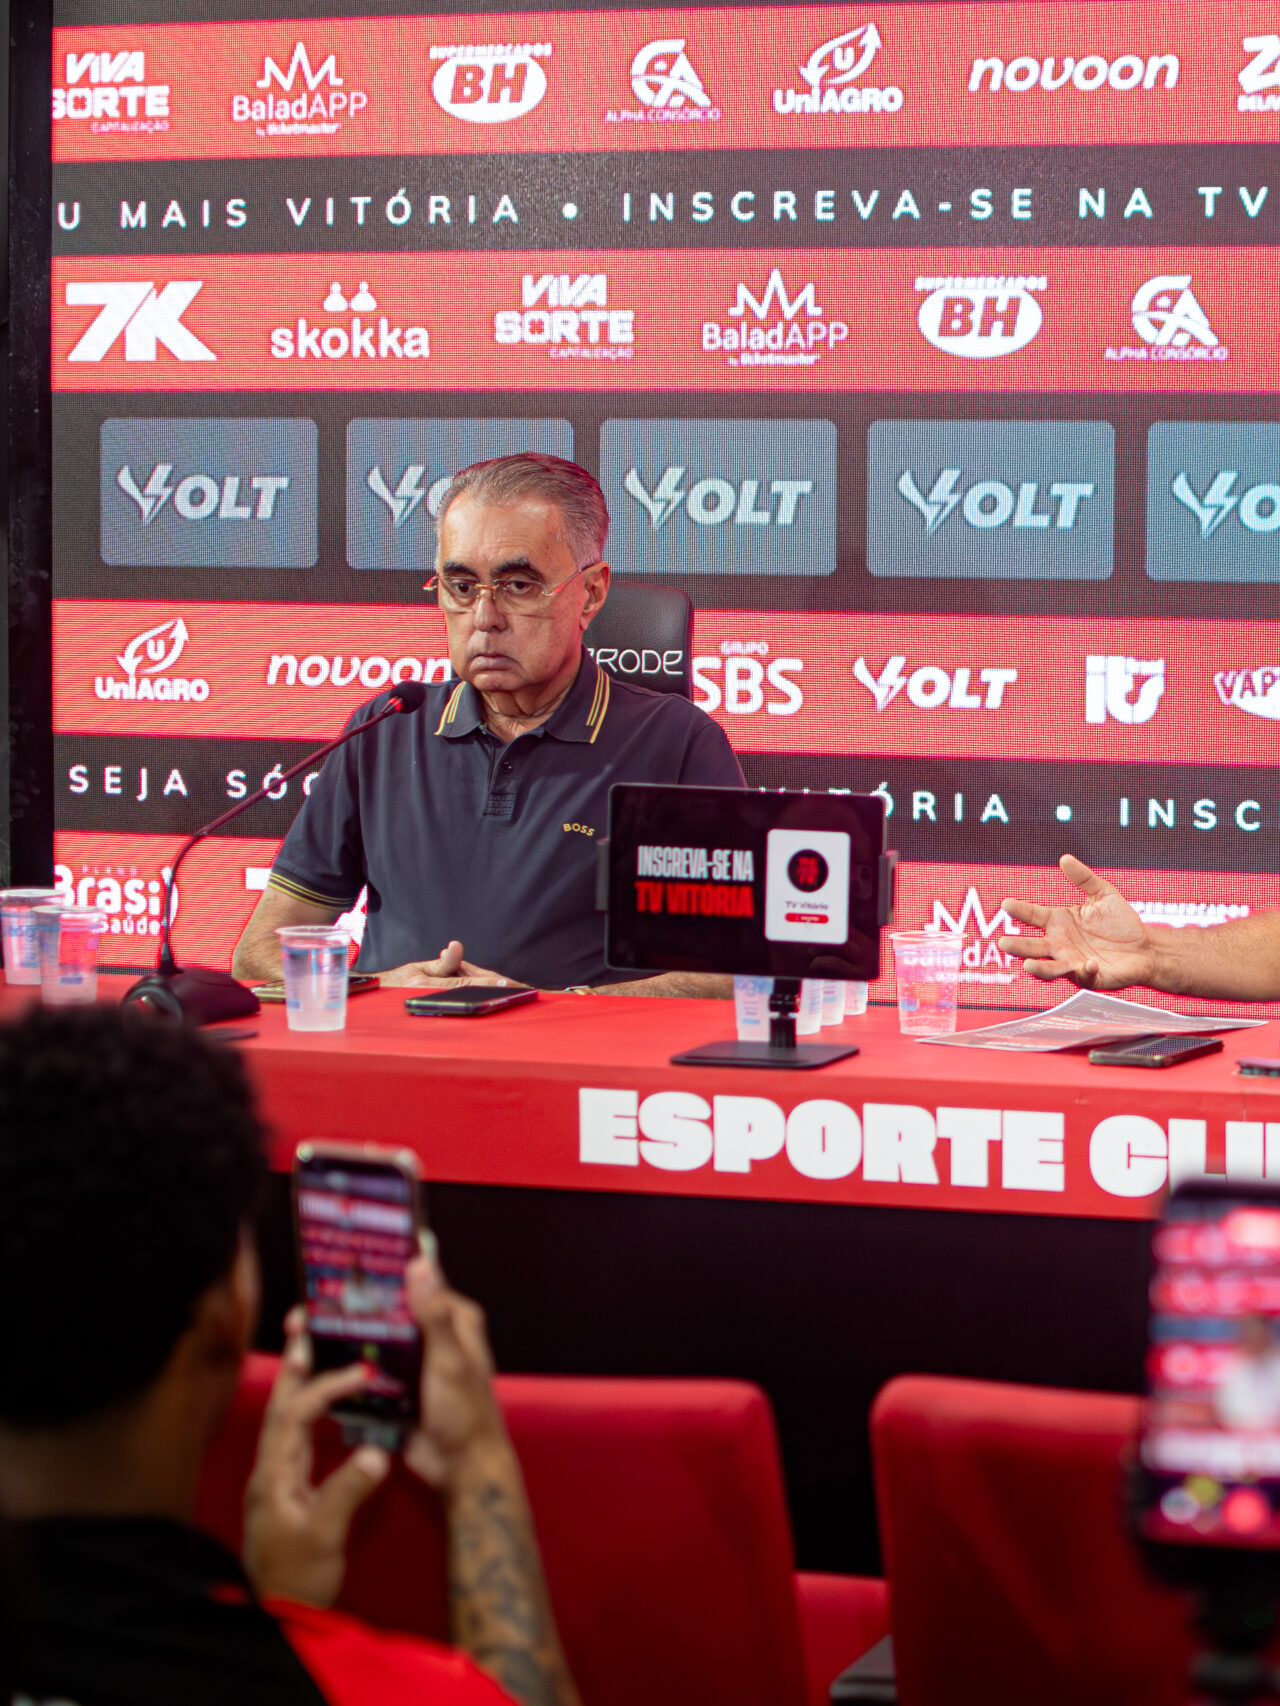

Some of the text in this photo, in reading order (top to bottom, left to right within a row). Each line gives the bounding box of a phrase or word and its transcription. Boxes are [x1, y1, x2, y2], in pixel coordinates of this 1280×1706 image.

[67, 51, 144, 83] VIVA
[450, 63, 528, 104] BH
[969, 55, 1179, 91] novoon
[53, 86, 170, 119] SORTE
[232, 91, 368, 121] BaladAPP
[121, 199, 247, 228] MAIS
[287, 188, 519, 226] VITÓRIA
[623, 188, 1032, 222] INSCREVA-SE
[1079, 188, 1152, 218] NA
[1198, 187, 1268, 217] TV
[523, 275, 606, 306] VIVA
[66, 281, 216, 361] 7K
[496, 311, 634, 343] SORTE
[938, 296, 1021, 337] BH
[272, 318, 429, 358] skokka
[702, 322, 848, 350] BaladAPP
[118, 464, 289, 524] VOLT
[625, 467, 812, 529] VOLT
[899, 469, 1094, 534] VOLT
[588, 648, 683, 675] RODE
[693, 657, 803, 715] SBS
[854, 656, 1017, 709] VOLT
[70, 765, 187, 801] SEJA
[563, 822, 595, 836] BOSS
[637, 845, 754, 882] INSCREVA-SE NA
[634, 881, 755, 918] TV VITÓRIA
[580, 1088, 1064, 1191] ESPORTE
